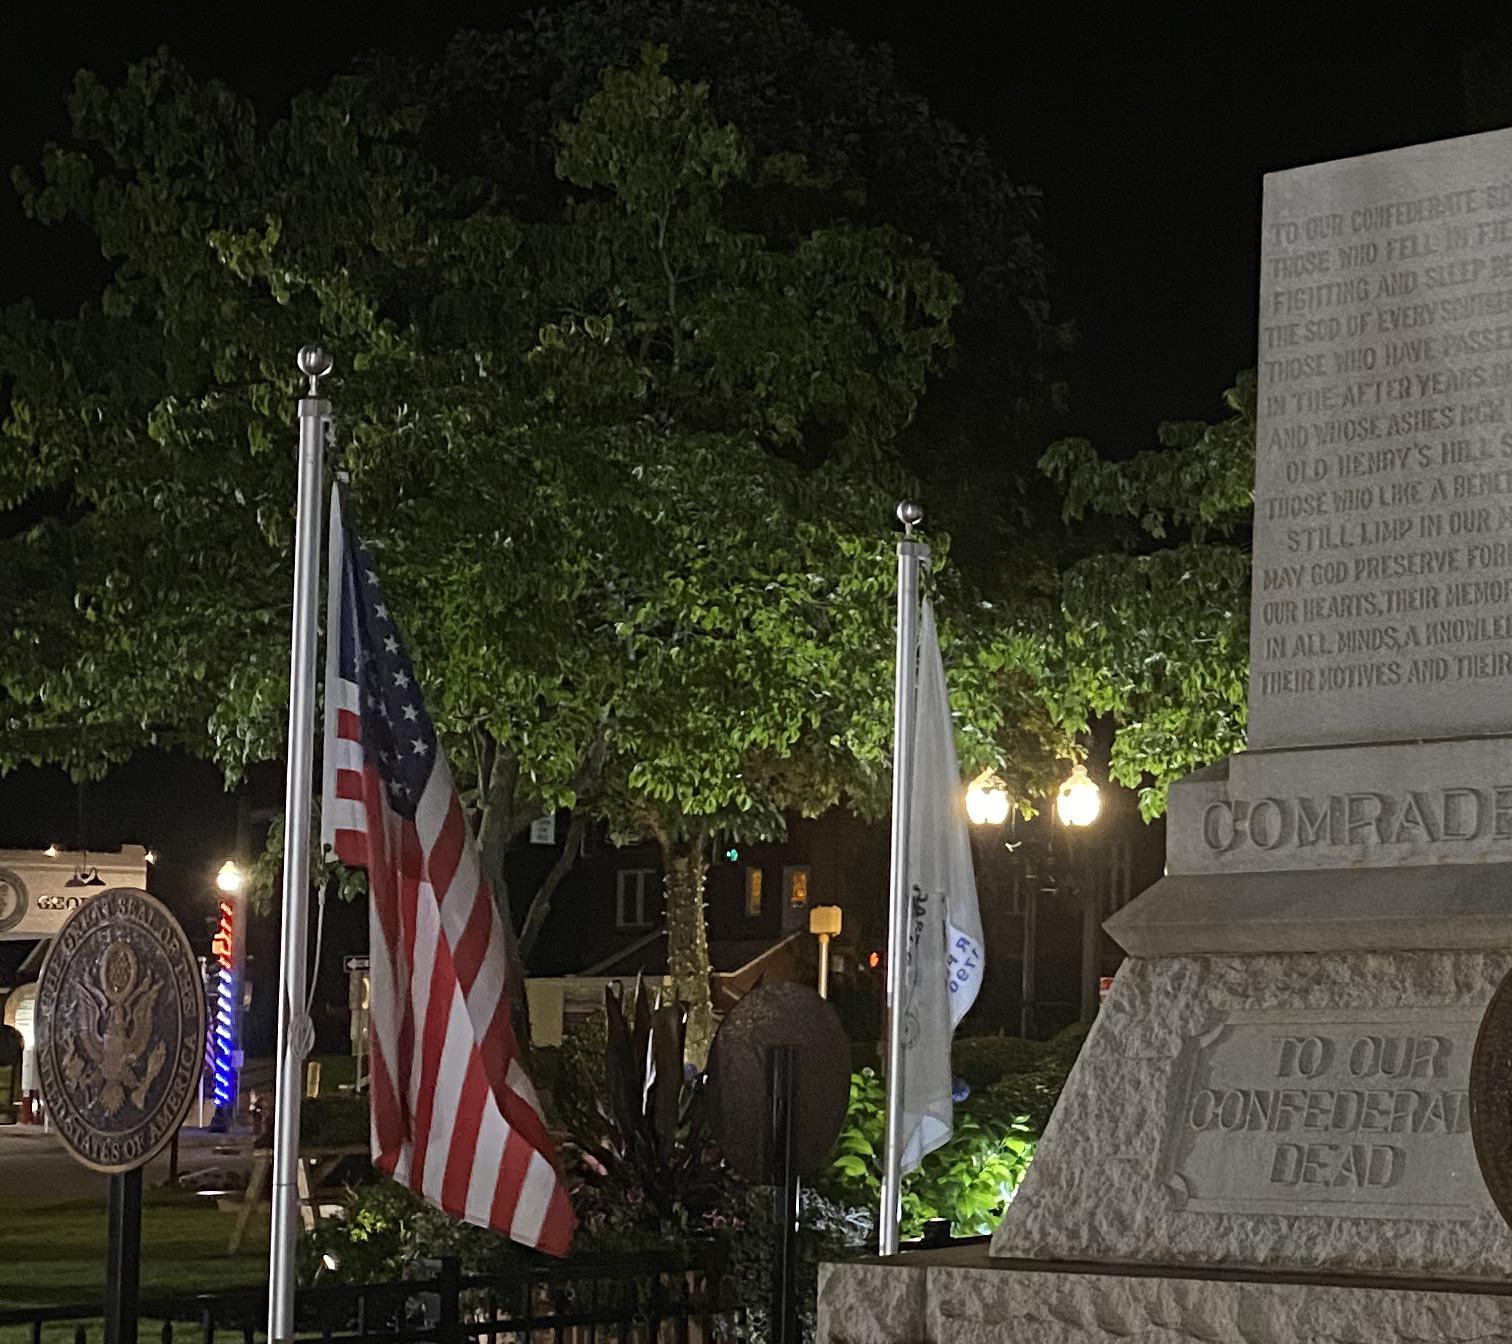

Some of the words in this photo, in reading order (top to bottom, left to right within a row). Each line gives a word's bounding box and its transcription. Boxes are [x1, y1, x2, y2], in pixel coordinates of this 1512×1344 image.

[1271, 221, 1299, 246] TO
[1306, 213, 1344, 242] OUR
[1351, 188, 1478, 234] CONFEDERATE
[1270, 250, 1331, 279] THOSE
[1337, 242, 1379, 270] WHO
[1386, 233, 1440, 262] FELL
[1446, 225, 1469, 250] IN
[1273, 278, 1369, 318] FIGHTING
[1374, 270, 1419, 300] AND
[1425, 258, 1486, 289] SLEEP
[1265, 323, 1300, 349] THE
[1304, 317, 1341, 343] SOD
[1347, 312, 1372, 337] OF
[1377, 301, 1437, 334] EVERY
[1265, 354, 1328, 383] THOSE
[1332, 347, 1377, 374] WHO
[1384, 337, 1438, 367] HAVE
[1267, 394, 1287, 418] IN
[1292, 387, 1338, 414] THE
[1342, 375, 1412, 408] AFTER
[1415, 365, 1487, 398] YEARS
[1268, 425, 1309, 453] AND
[1312, 416, 1382, 446] WHOSE
[1386, 406, 1455, 437] ASHES
[1459, 397, 1505, 428] NOW
[1286, 457, 1329, 485] OLD
[1337, 441, 1432, 479] HENRY'S
[1441, 437, 1495, 466] HILL
[1265, 491, 1329, 521] THOSE
[1332, 487, 1374, 514] WHO
[1379, 481, 1424, 507] LIKE
[1430, 477, 1449, 503] A
[1286, 524, 1356, 553] STILL
[1361, 517, 1414, 546] LIMP
[1419, 513, 1443, 539] IN
[1449, 508, 1491, 536] OUR
[1263, 564, 1306, 591] MAY
[1311, 560, 1349, 587] GOD
[1354, 546, 1461, 583] PRESERVE
[1263, 599, 1299, 626] OUR
[1303, 591, 1384, 624] HEARTS,
[1384, 585, 1440, 614] THEIR
[1265, 634, 1287, 660] IN
[1292, 629, 1333, 658] ALL
[1336, 625, 1403, 654] MINDS,
[1403, 624, 1422, 648] A
[1260, 668, 1315, 697] THEIR
[1318, 660, 1402, 691] MOTIVES
[1407, 656, 1450, 684] AND
[37, 895, 89, 910] GEO
[118, 896, 154, 927] SEAL
[1273, 1035, 1333, 1080] TO
[1349, 1034, 1452, 1080] OUR
[149, 1033, 199, 1145] AMERICA
[63, 1116, 121, 1162] STATES
[123, 1132, 146, 1160] OF
[1268, 1143, 1404, 1189] DEAD
